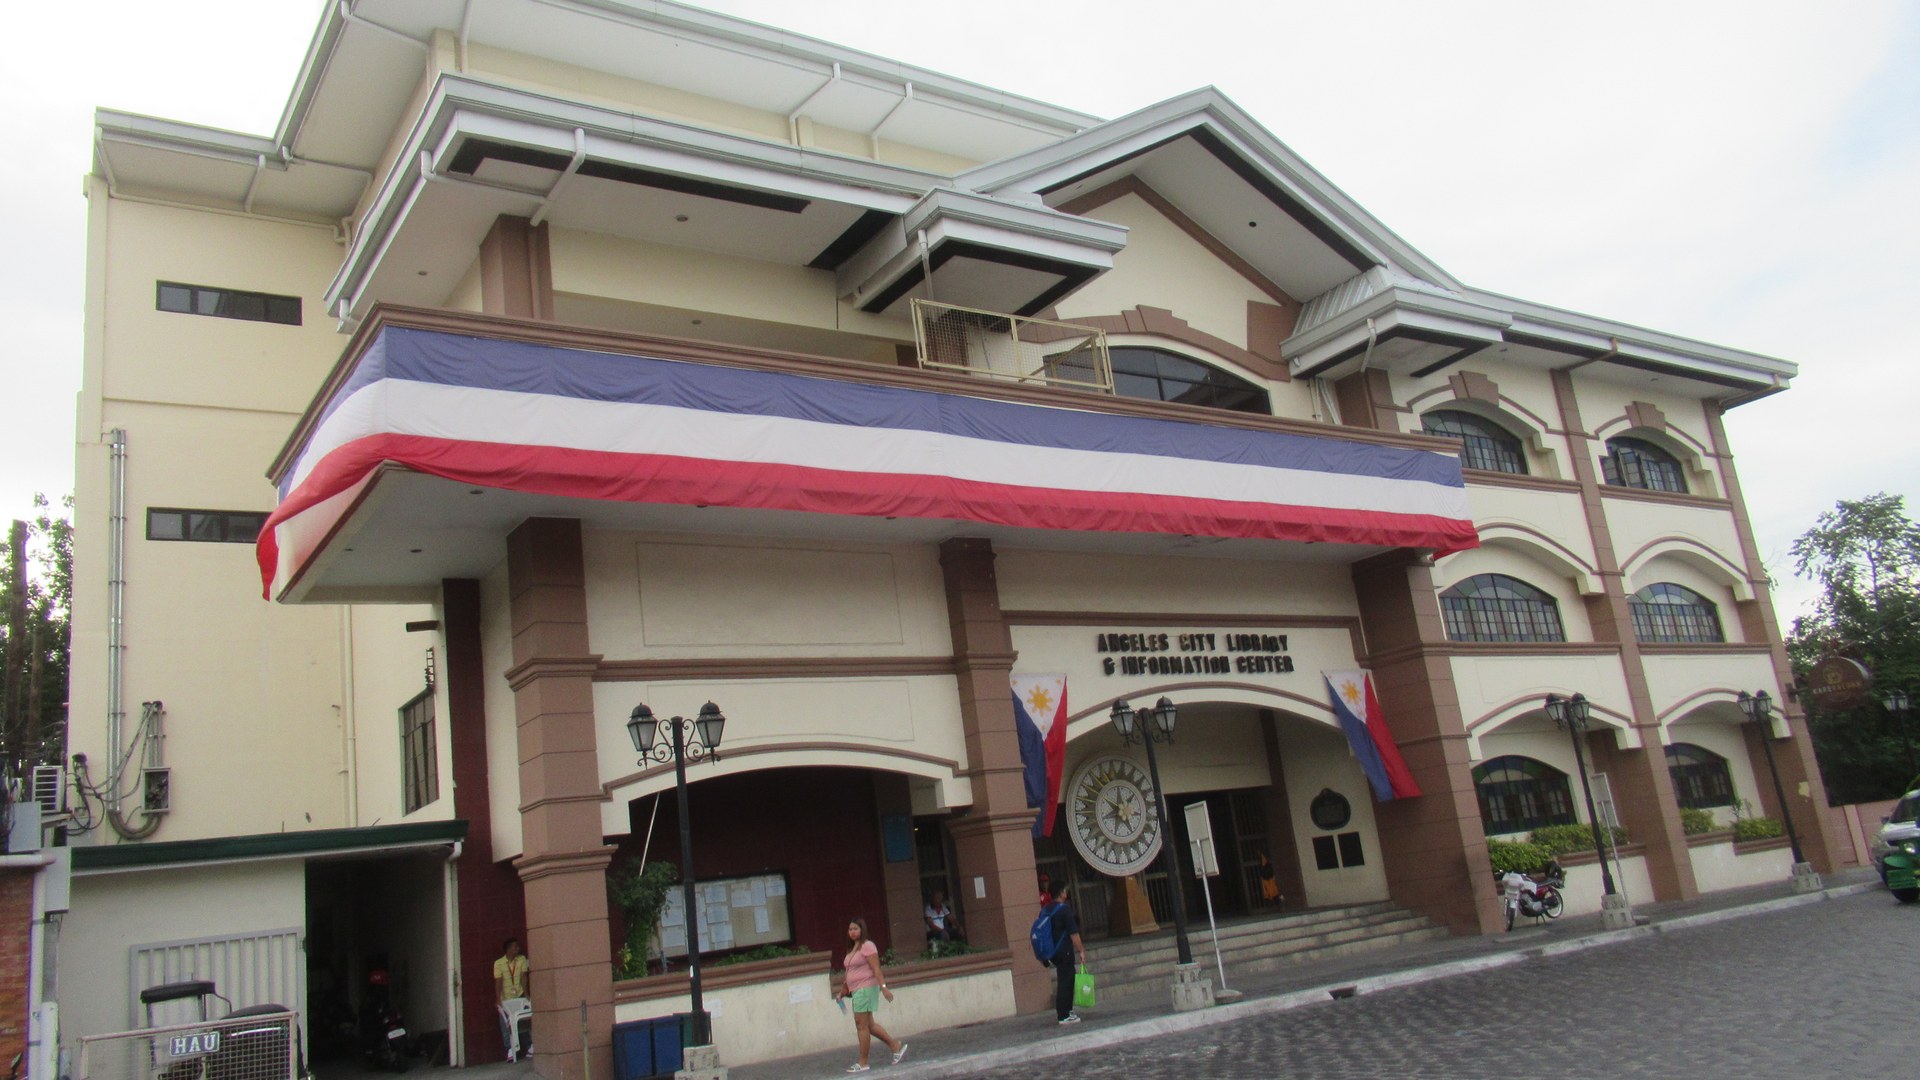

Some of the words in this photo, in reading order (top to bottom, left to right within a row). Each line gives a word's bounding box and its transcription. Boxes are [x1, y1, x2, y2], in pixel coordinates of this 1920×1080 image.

[1098, 633, 1169, 652] ANGELES
[1179, 633, 1215, 652] CITY
[1226, 633, 1288, 652] LIBRARY
[1121, 656, 1230, 674] INFORMATION
[1236, 656, 1294, 673] CENTER
[174, 1034, 216, 1054] HAU
